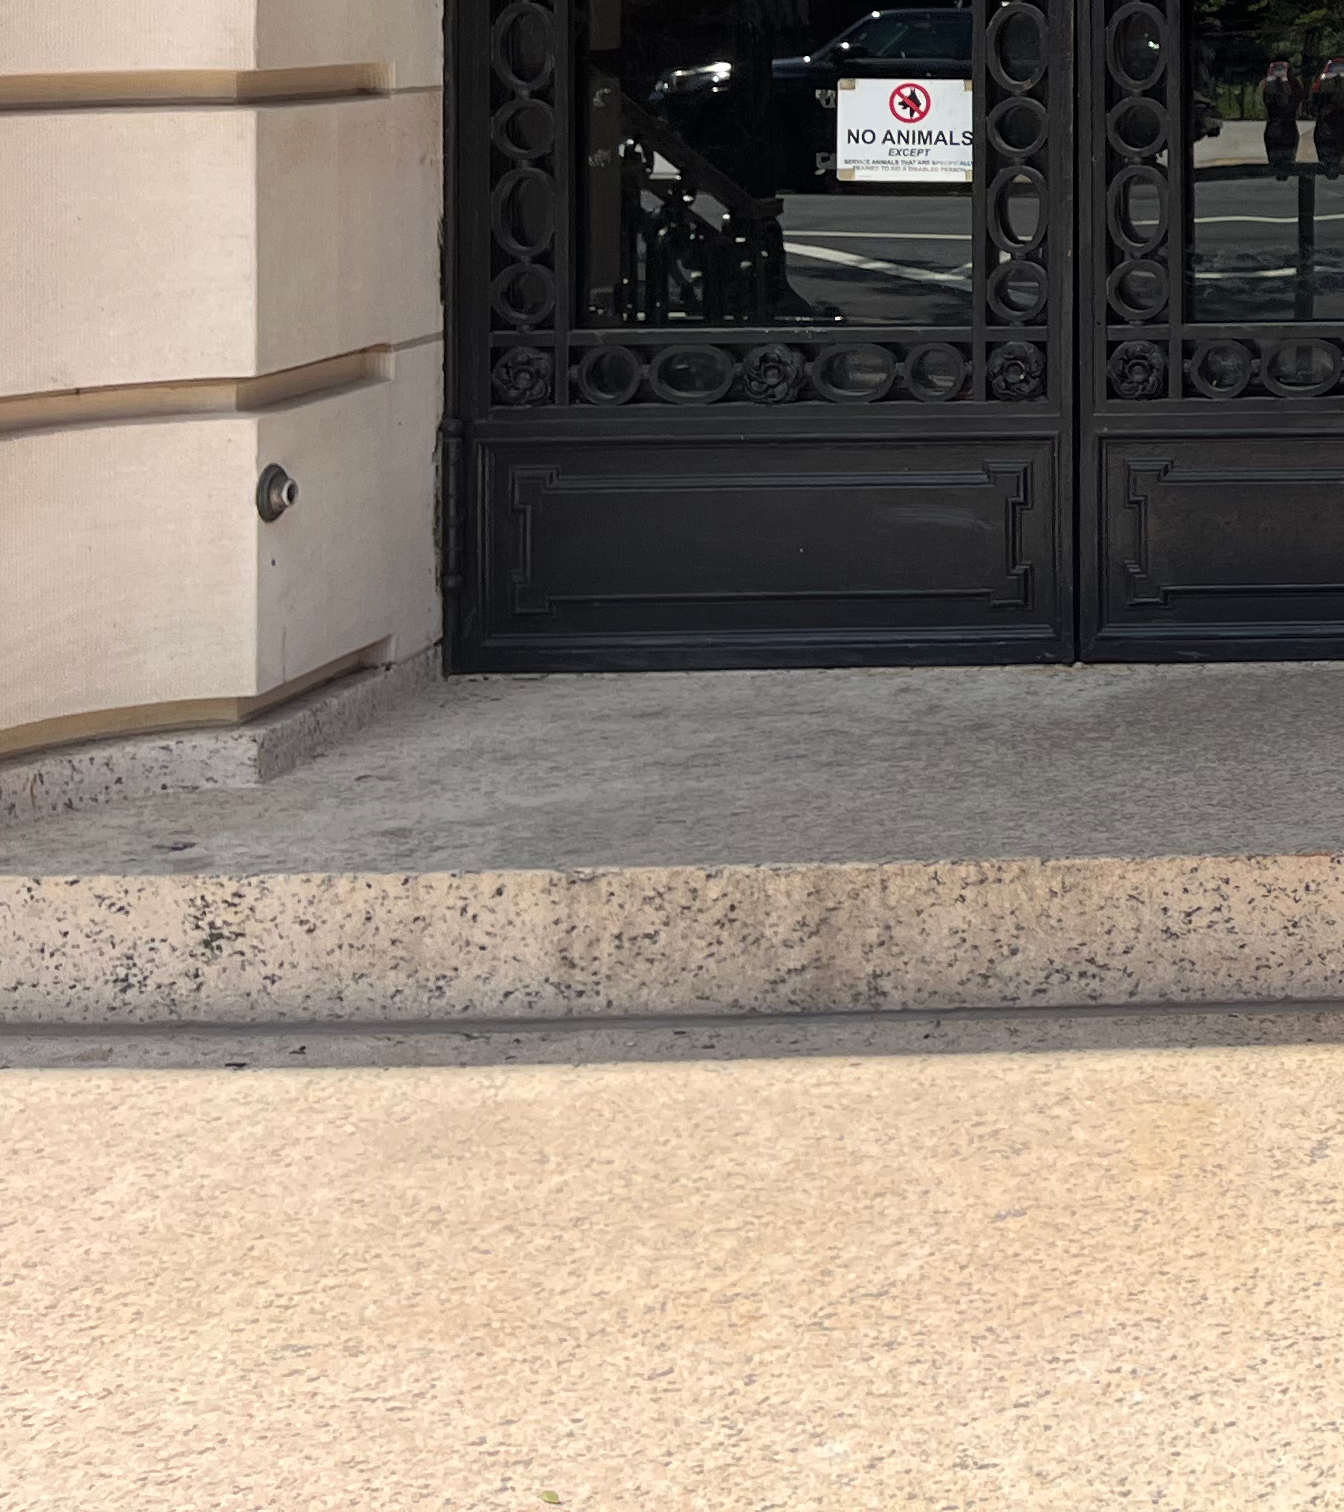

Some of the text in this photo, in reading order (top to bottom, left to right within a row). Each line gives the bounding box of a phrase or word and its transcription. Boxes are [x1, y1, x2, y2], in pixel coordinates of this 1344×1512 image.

[847, 129, 974, 146] NO ANIMALS
[887, 147, 931, 157] EXCEPT
